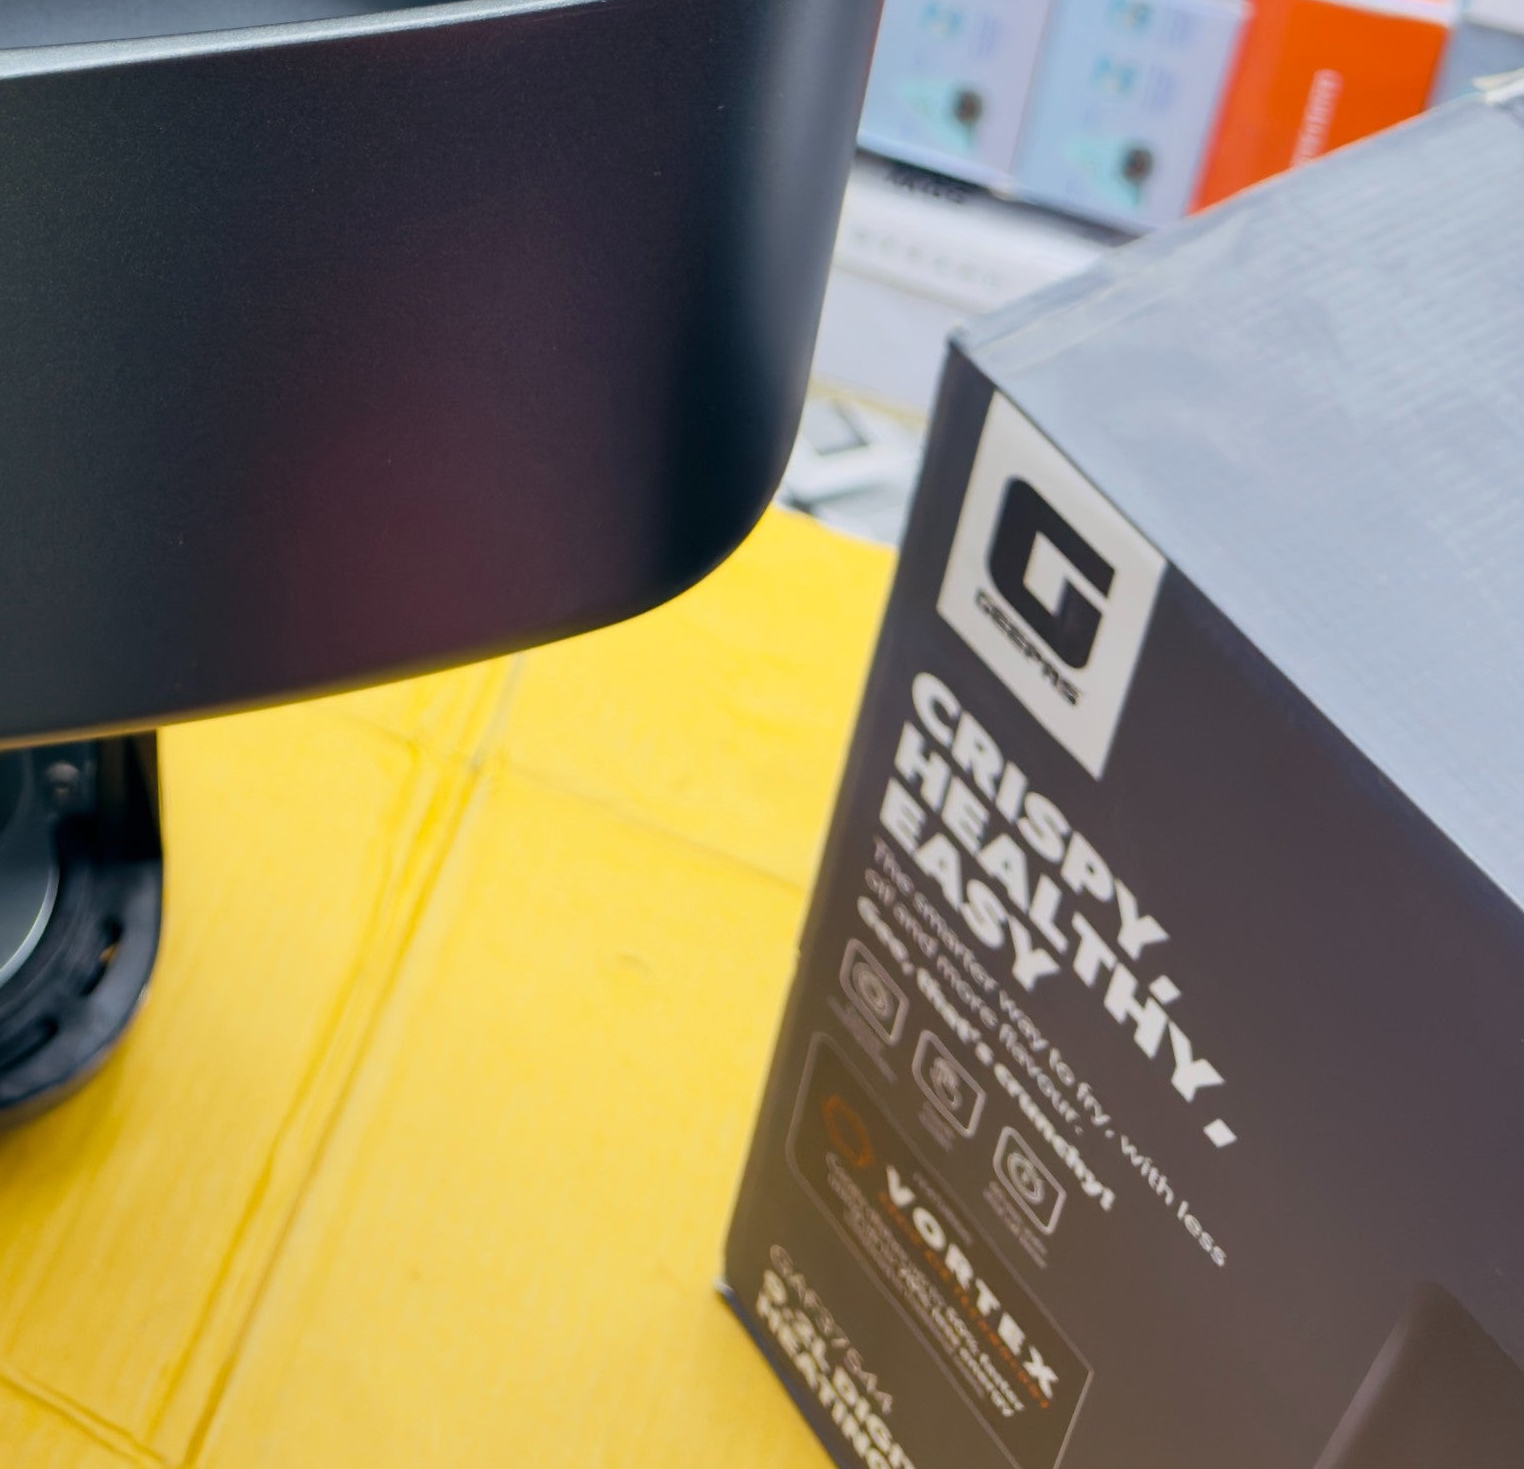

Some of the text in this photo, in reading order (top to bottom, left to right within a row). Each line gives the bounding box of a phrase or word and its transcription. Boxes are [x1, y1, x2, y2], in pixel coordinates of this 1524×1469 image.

[880, 779, 1059, 990] EASY
[895, 724, 1236, 1147] HEALTHY,
[912, 673, 1180, 1004] CRISPY,
[894, 904, 937, 957] and
[937, 956, 998, 1027] more
[999, 1024, 1083, 1134] flavour.
[915, 893, 997, 991] smarter
[1000, 992, 1048, 1051] way
[1049, 1048, 1074, 1086] to
[1077, 1083, 1114, 1137] fry,
[1121, 1136, 1173, 1205] with
[1178, 1201, 1223, 1265] less
[994, 1064, 1114, 1210] crunchy!
[887, 1169, 1058, 1398] VORTEX
